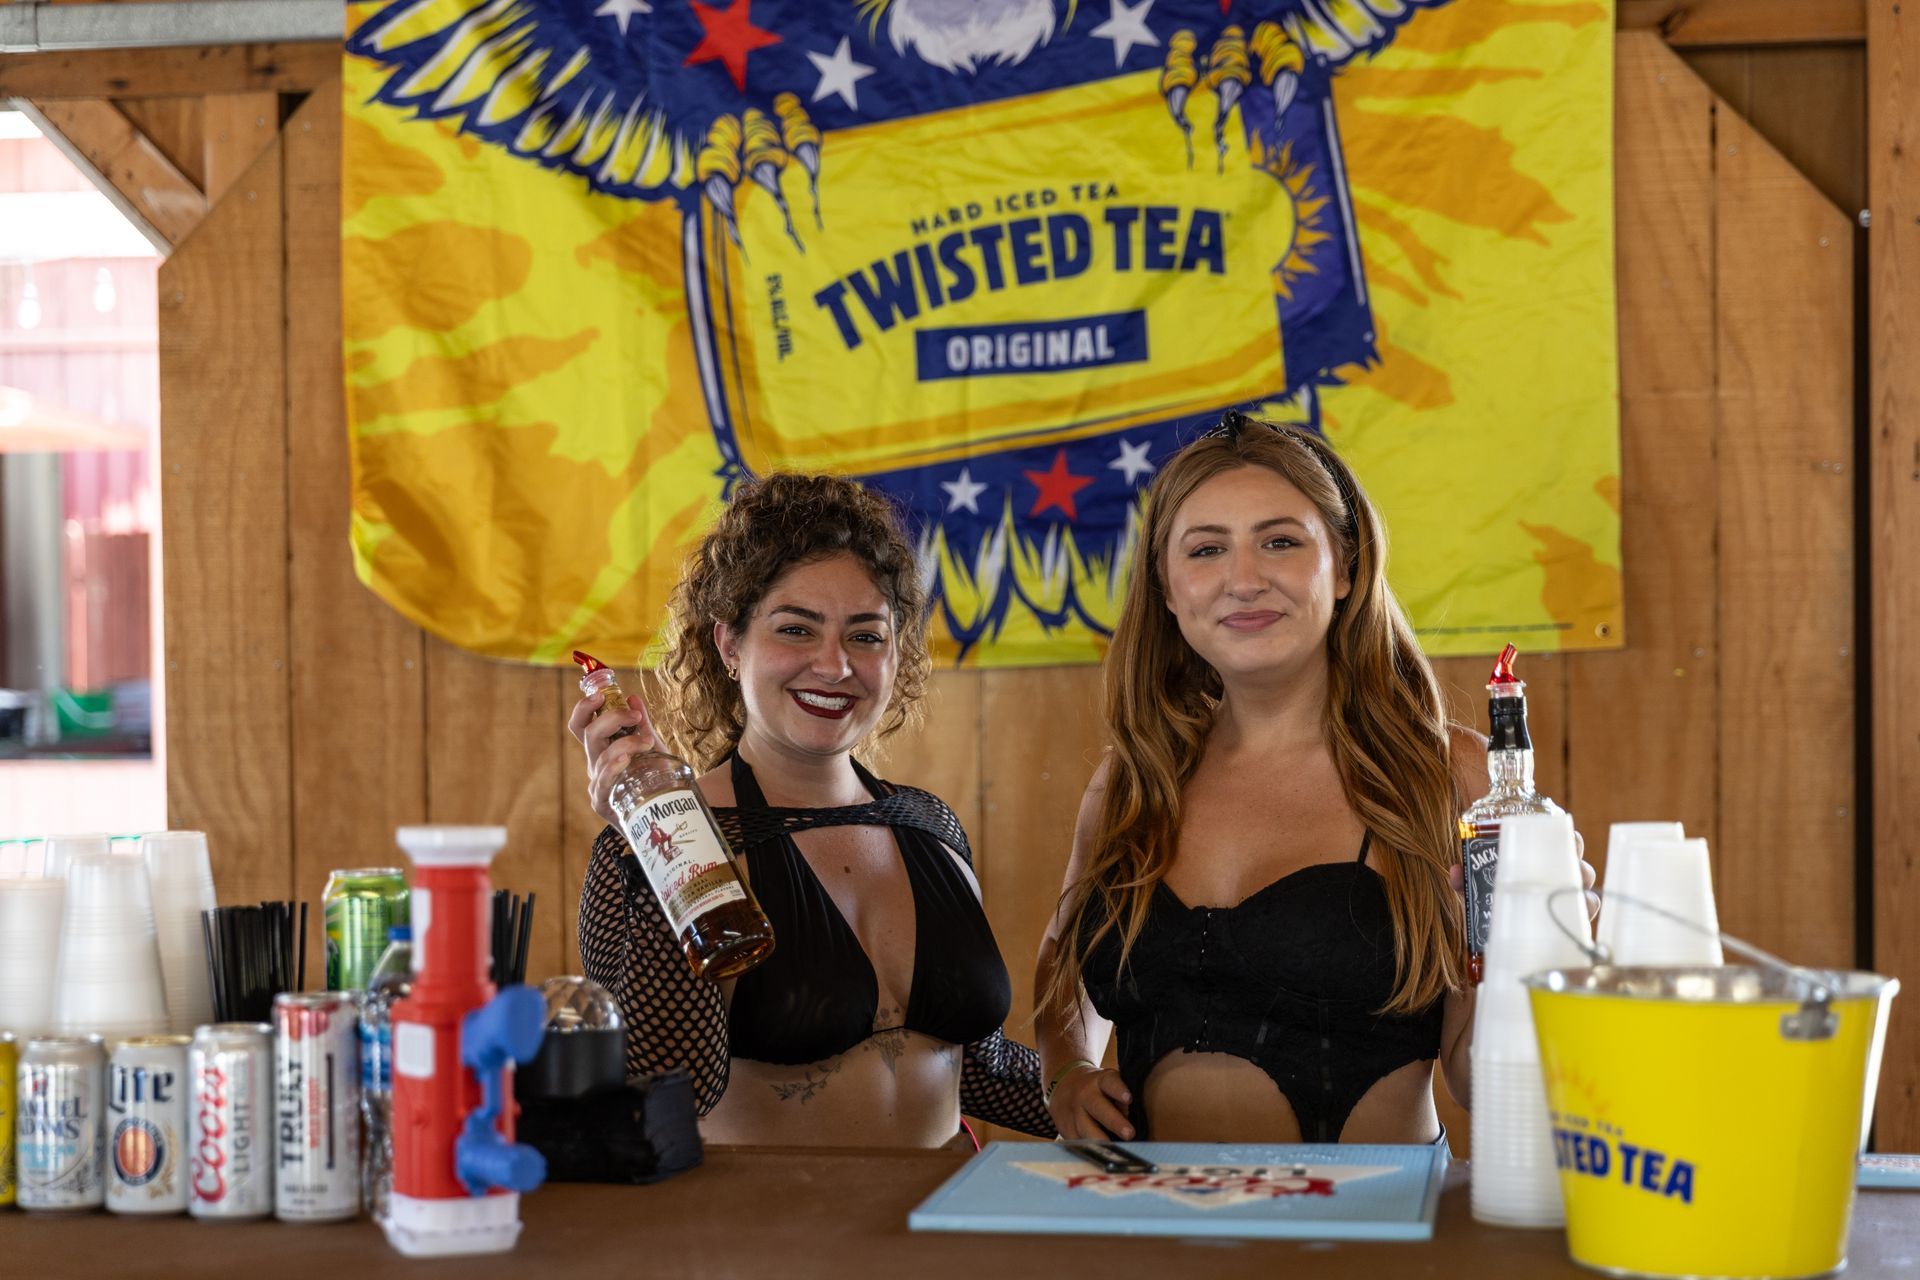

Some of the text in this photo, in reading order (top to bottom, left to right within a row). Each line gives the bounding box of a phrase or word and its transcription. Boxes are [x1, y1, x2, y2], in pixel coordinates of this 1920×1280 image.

[911, 182, 1119, 235] HARD ICED TEA
[812, 212, 1094, 351] TWISTED
[1102, 206, 1226, 276] TEA
[945, 325, 1116, 371] ORIGINAL
[648, 794, 699, 823] Morgan
[687, 860, 719, 882] Rum
[1470, 846, 1499, 871] JACK
[192, 1065, 227, 1204] Coors
[233, 1102, 250, 1173] LIGHT
[1618, 1142, 1697, 1204] TEA
